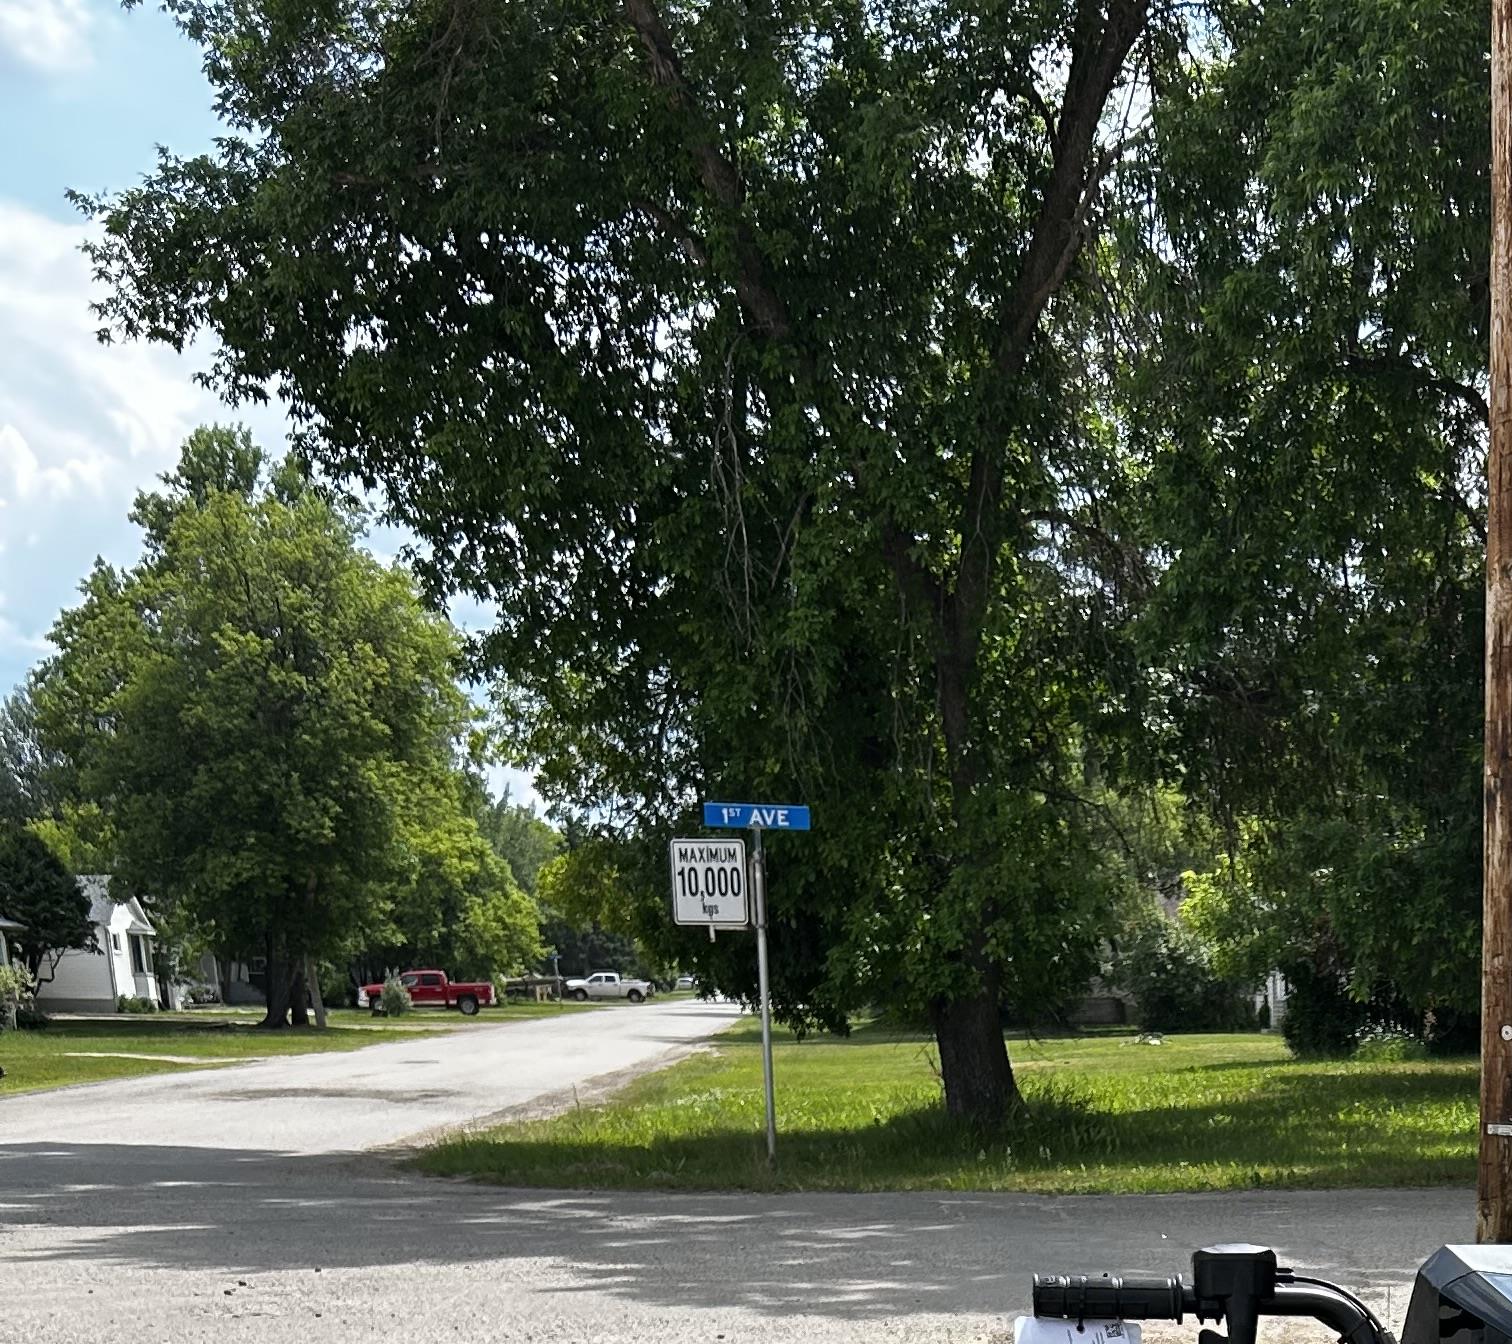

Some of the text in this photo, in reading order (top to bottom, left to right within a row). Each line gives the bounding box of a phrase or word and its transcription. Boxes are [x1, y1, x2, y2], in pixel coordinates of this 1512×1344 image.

[722, 808, 790, 826] 1ST AVE
[678, 847, 737, 863] MAXIMUM
[677, 866, 741, 899] 10,000
[702, 902, 719, 915] kgs
